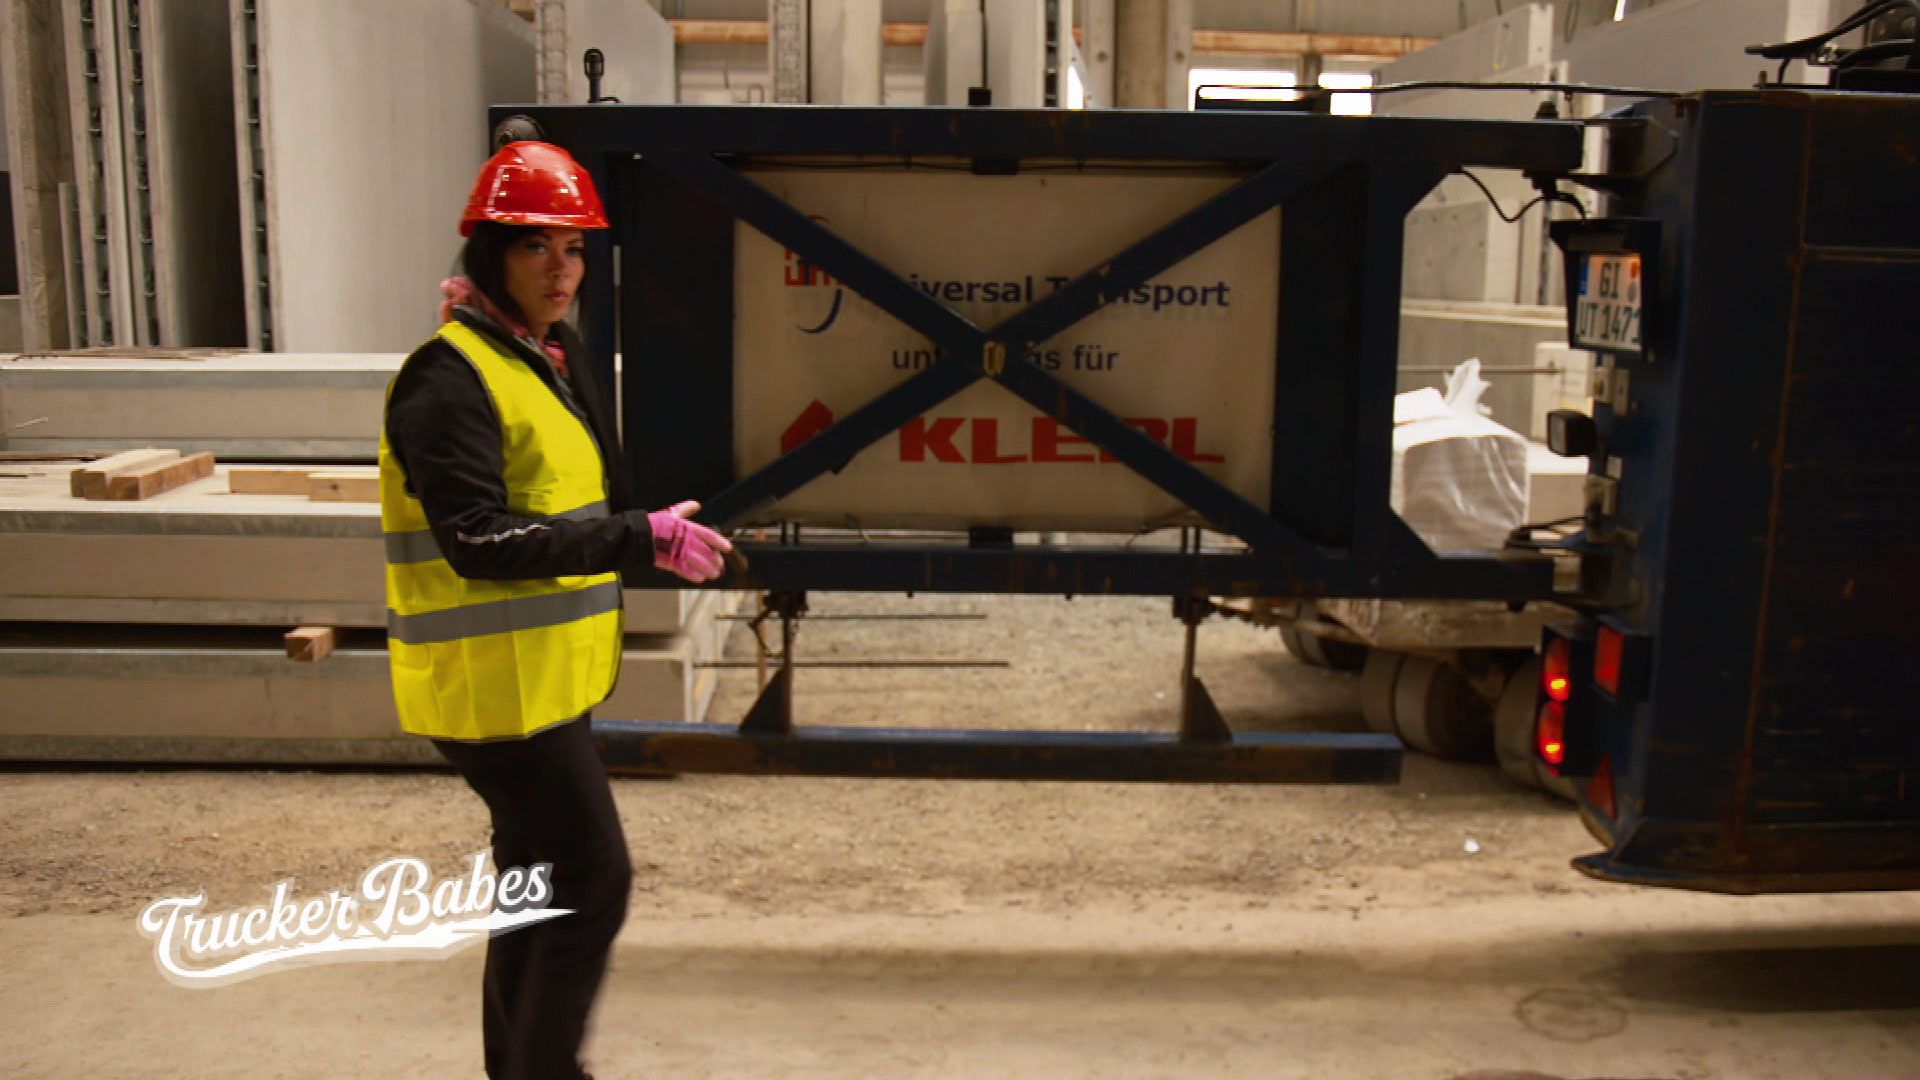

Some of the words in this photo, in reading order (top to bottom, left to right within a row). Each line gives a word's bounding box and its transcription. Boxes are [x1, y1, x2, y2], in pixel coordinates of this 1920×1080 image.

[909, 274, 1034, 303] versal
[1046, 276, 1231, 312] Tsport
[1599, 261, 1621, 299] GI
[1072, 344, 1120, 371] für
